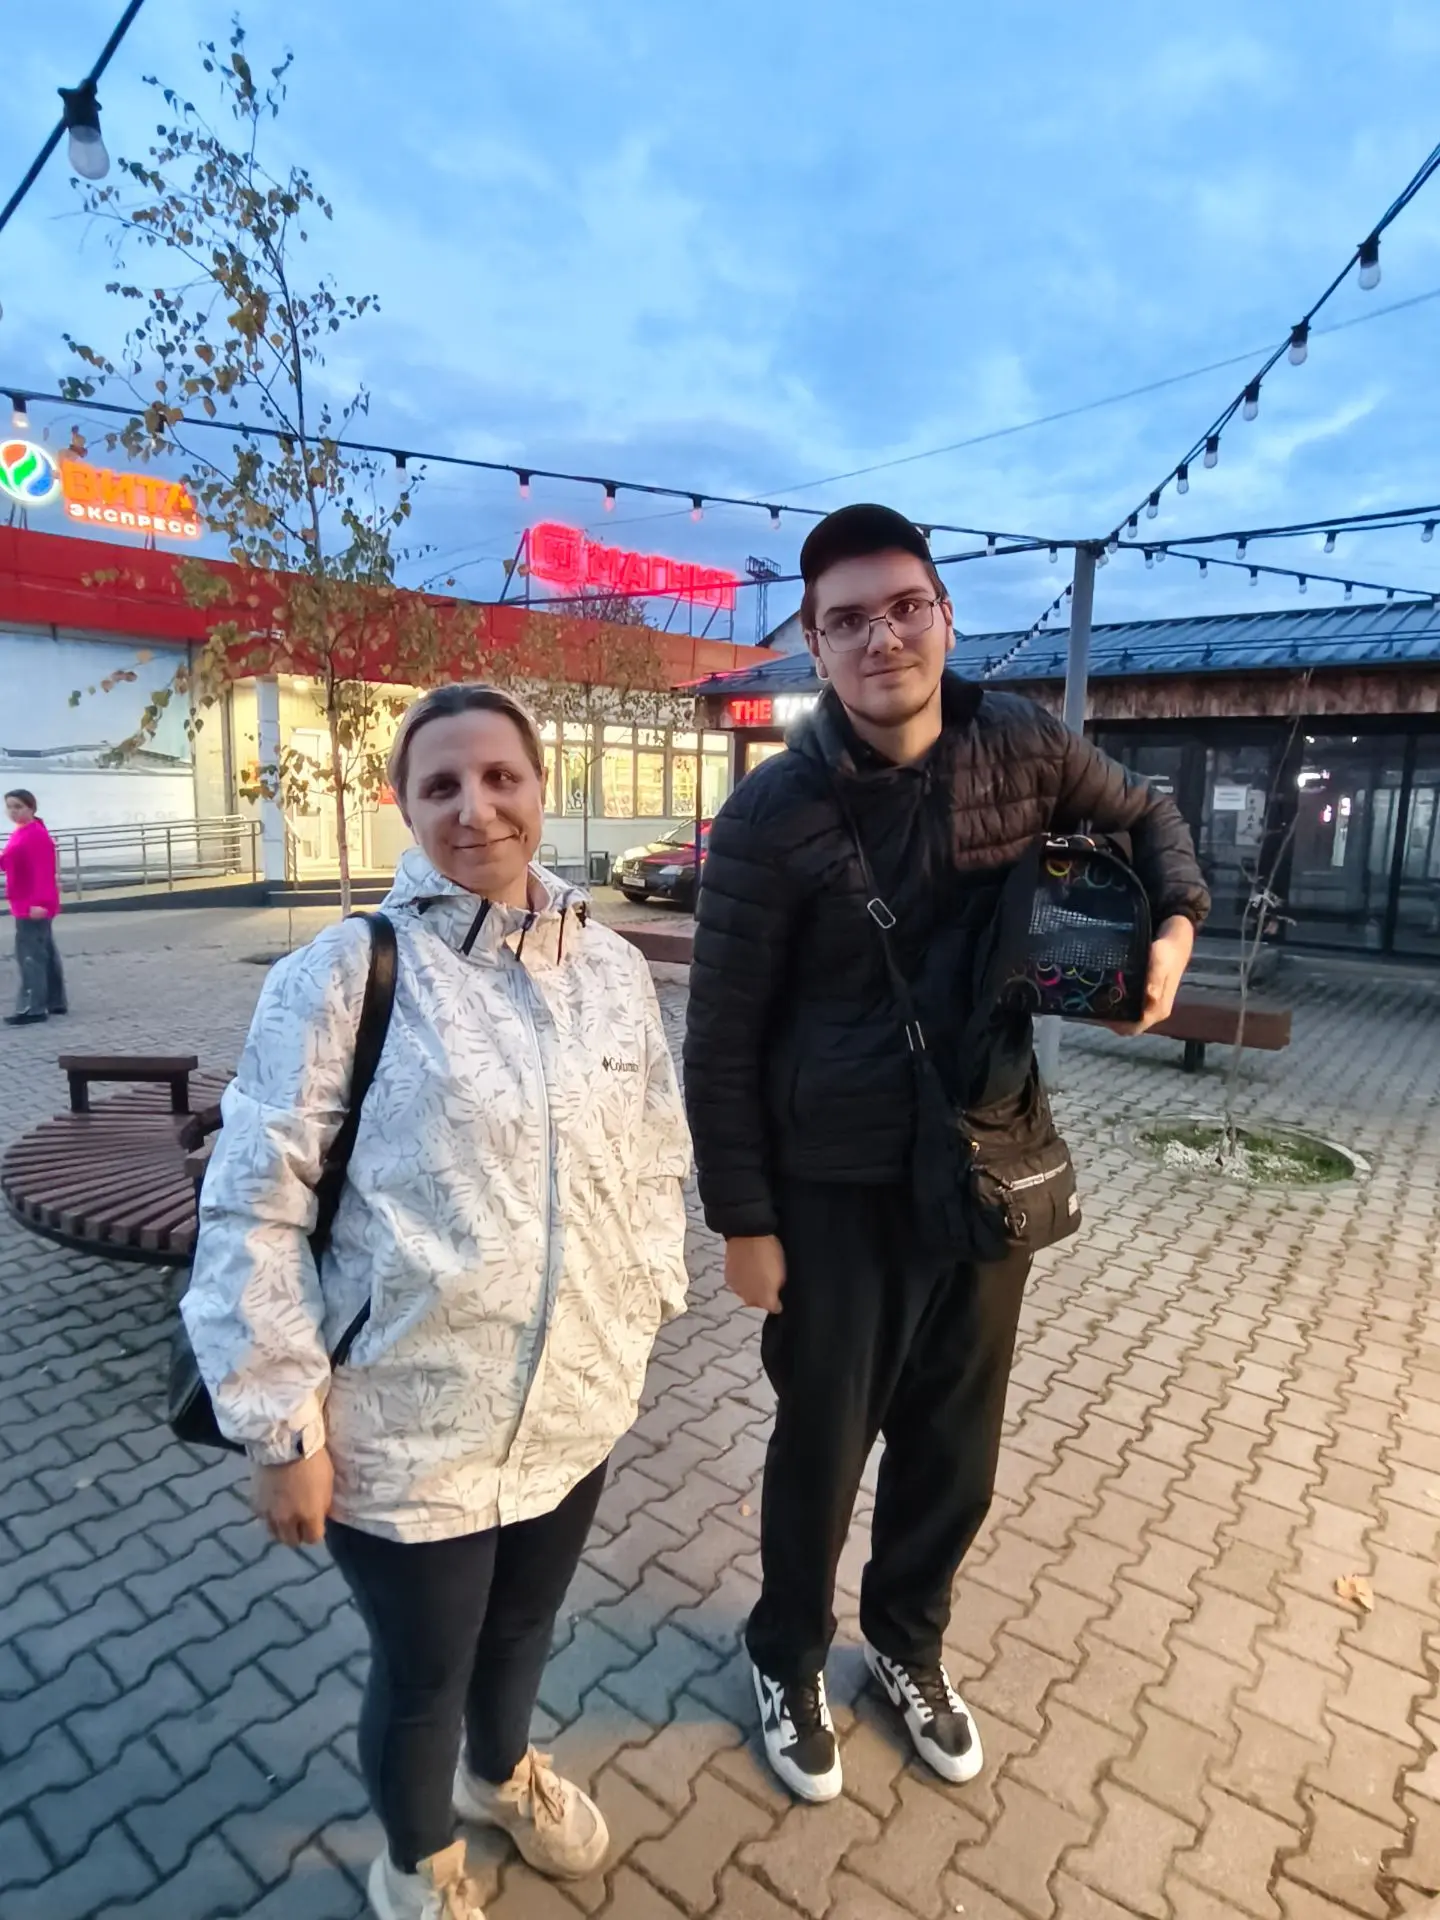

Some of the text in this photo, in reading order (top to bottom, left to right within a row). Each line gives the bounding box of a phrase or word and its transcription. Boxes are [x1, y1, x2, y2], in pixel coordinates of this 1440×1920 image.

[62, 460, 197, 518] ВИТА
[69, 503, 198, 536] ЭКСПРЕСС
[731, 699, 772, 720] THE
